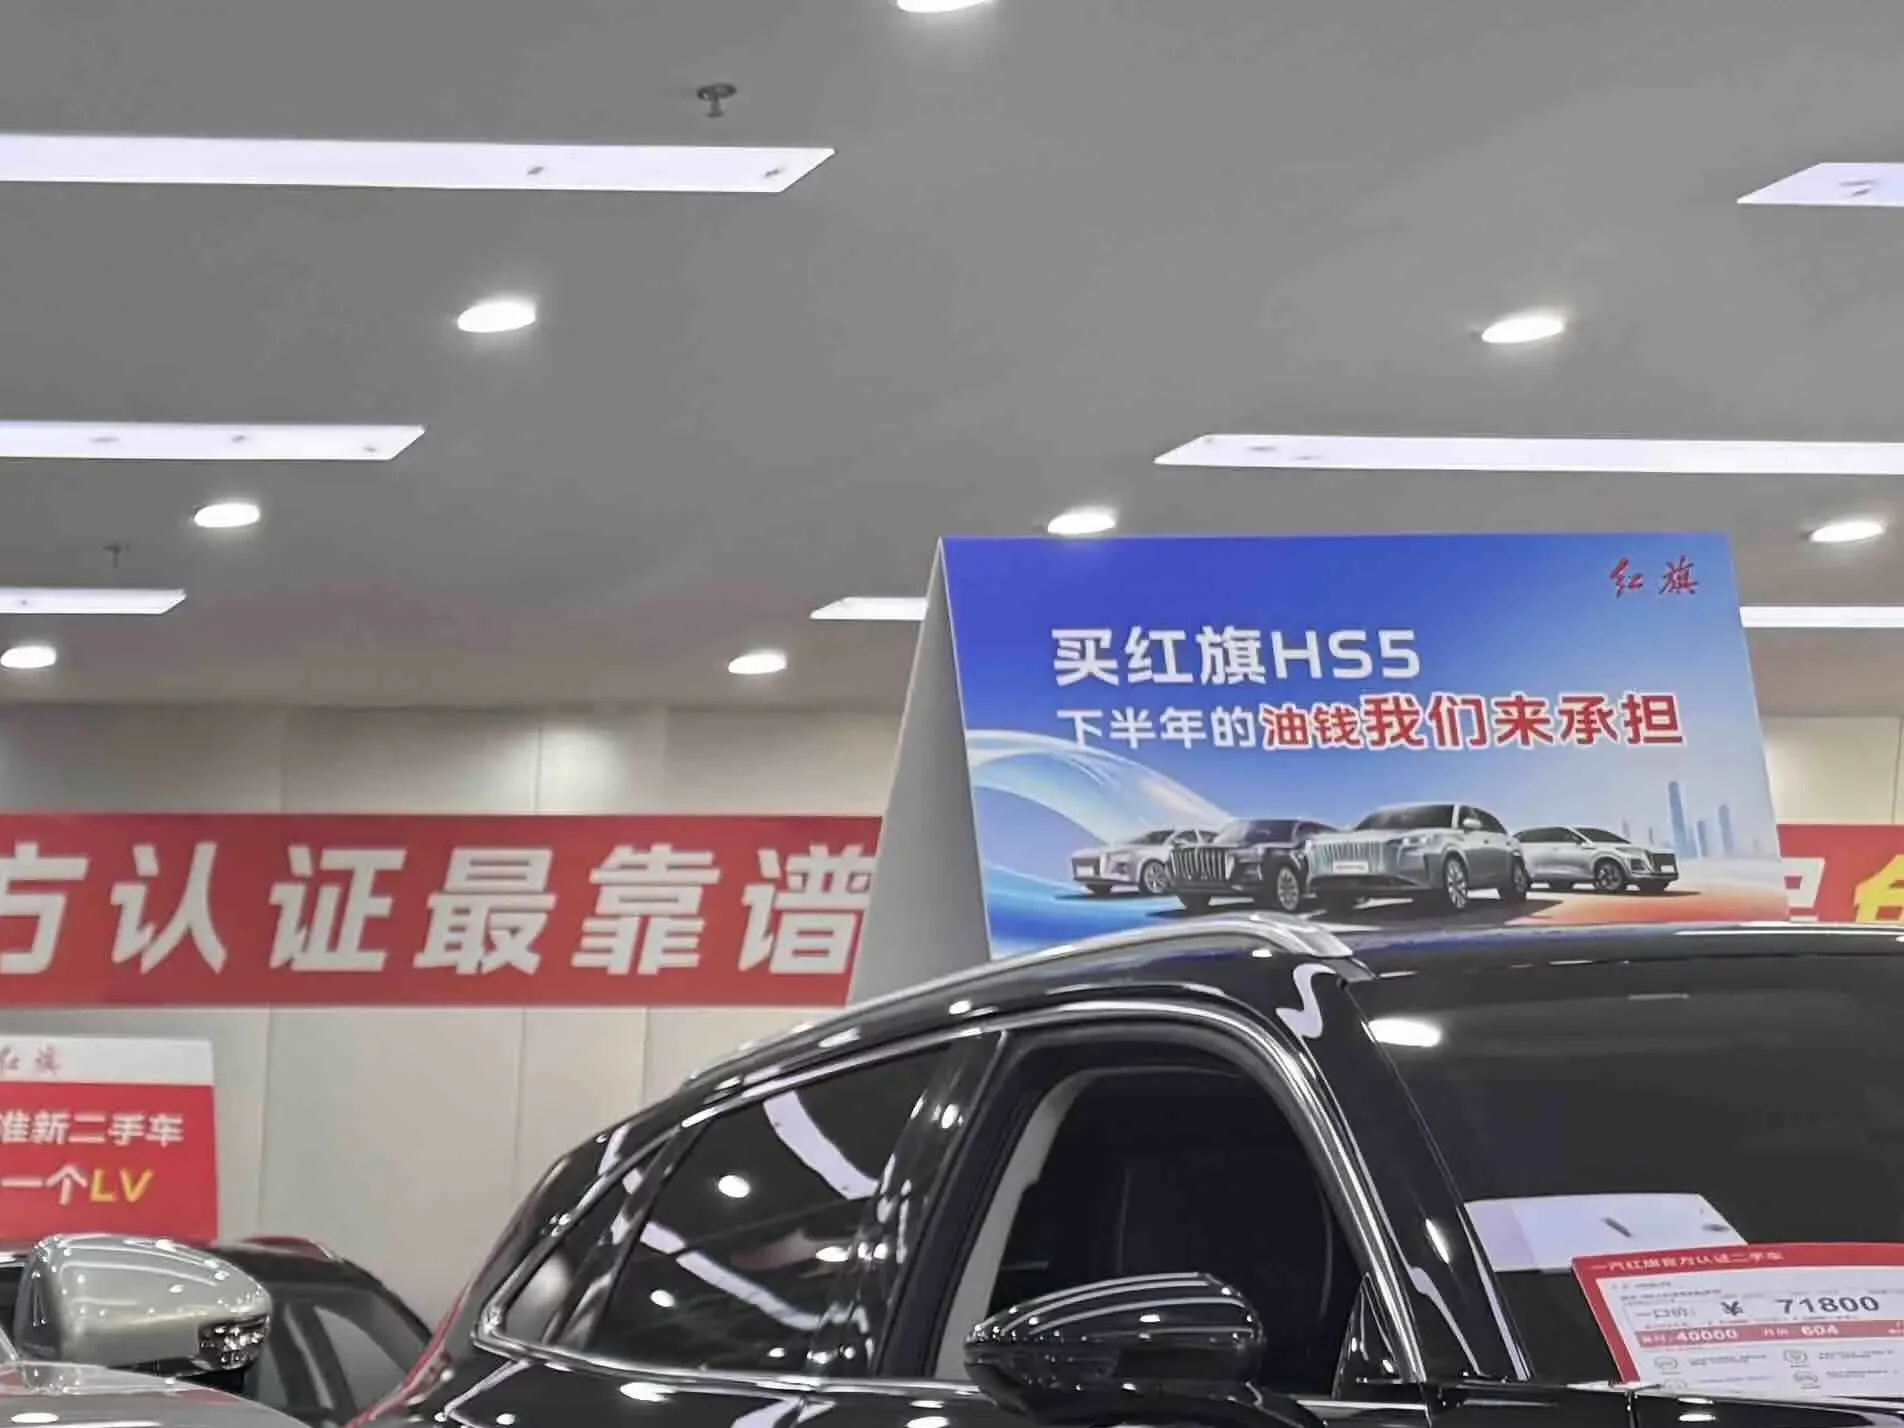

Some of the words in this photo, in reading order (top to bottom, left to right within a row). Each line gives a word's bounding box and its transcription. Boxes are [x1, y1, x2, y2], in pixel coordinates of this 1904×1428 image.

[1608, 554, 1699, 599] 红旗
[1051, 625, 1421, 687] 买红旗HS5
[1055, 690, 1685, 752] 下半年的油钱我们来承担
[1775, 1296, 1880, 1316] 71800
